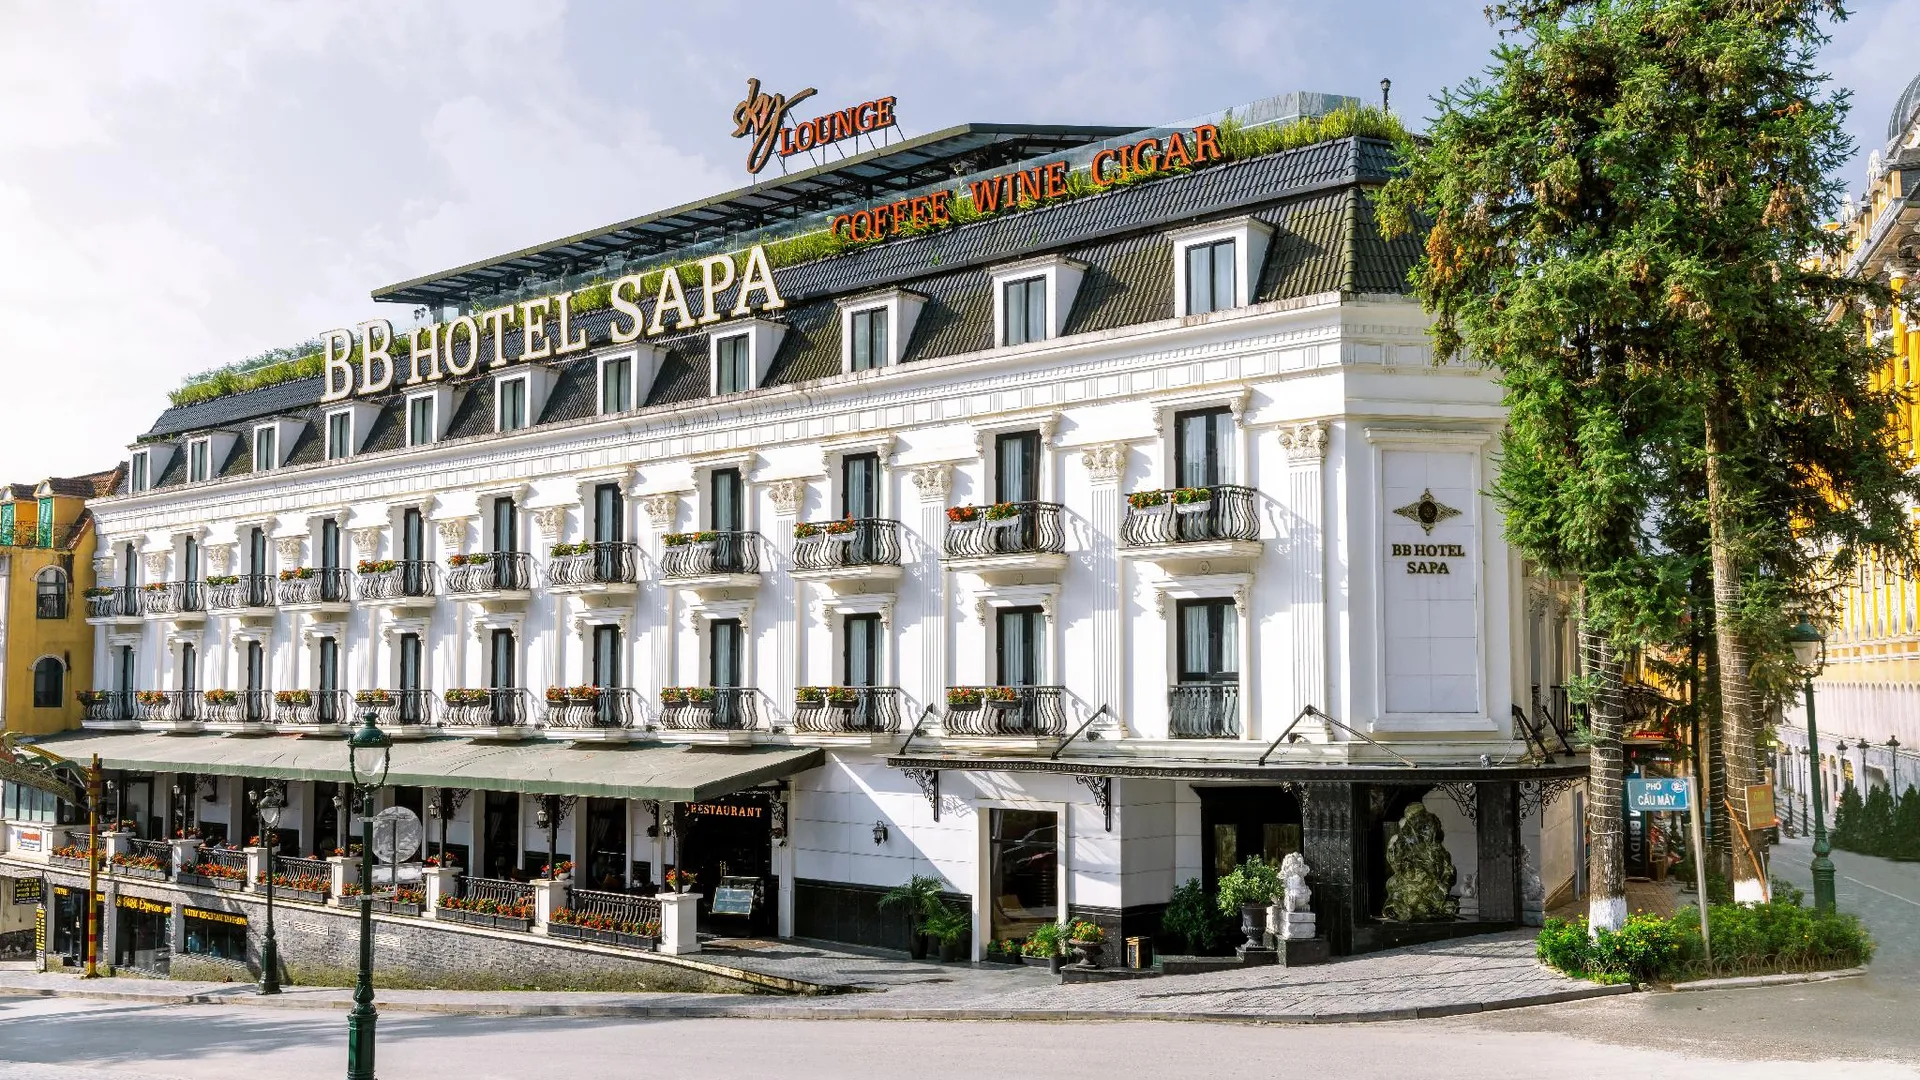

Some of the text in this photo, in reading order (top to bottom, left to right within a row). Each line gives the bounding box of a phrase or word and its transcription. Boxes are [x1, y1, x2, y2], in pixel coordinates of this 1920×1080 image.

[780, 96, 898, 158] LOUNGE
[831, 123, 1223, 243] COFFEE WINE CIGAR
[320, 245, 786, 403] BB HOTEL SAPA
[1392, 544, 1465, 557] BB HOTEL
[1407, 561, 1450, 575] SAPA
[690, 803, 762, 818] RESTAURANT
